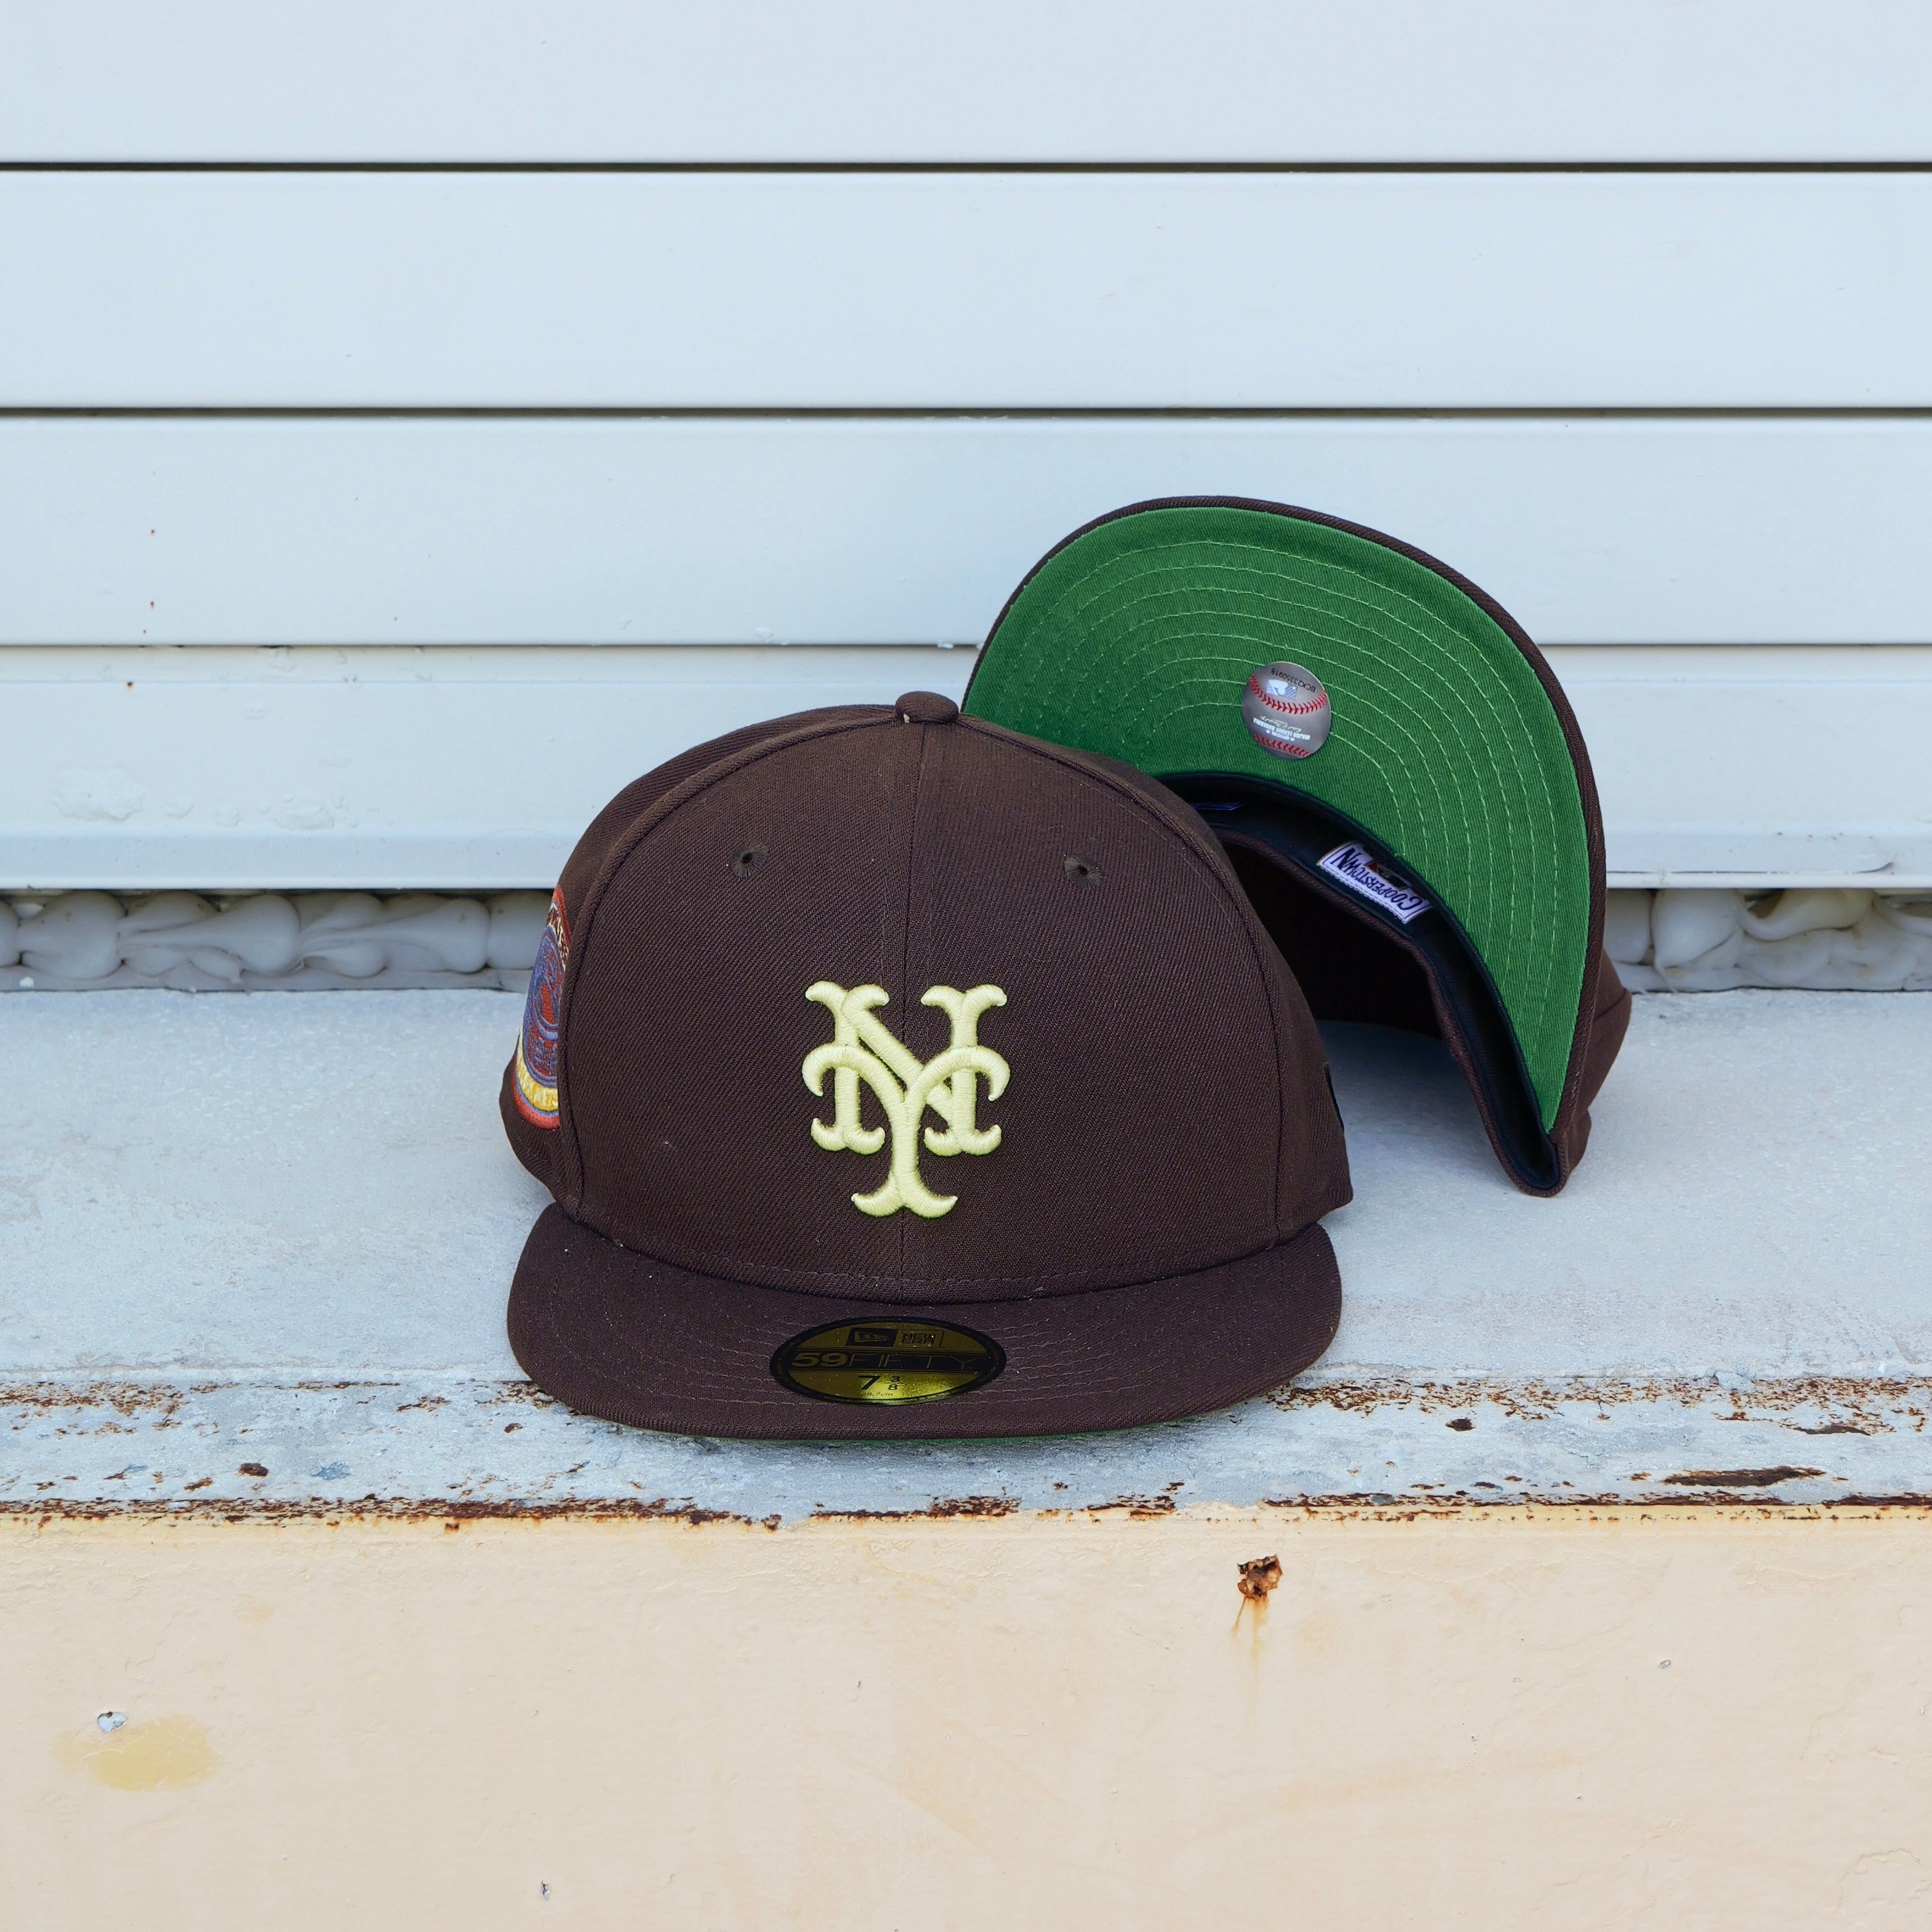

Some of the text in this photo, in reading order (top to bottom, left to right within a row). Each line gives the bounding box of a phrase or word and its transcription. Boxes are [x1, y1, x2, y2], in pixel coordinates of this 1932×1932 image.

[1330, 847, 1423, 910] COOPERSTOWN
[802, 980, 1011, 1218] NY
[792, 1352, 981, 1370] 59FIFTY
[858, 1375, 880, 1390] 7
